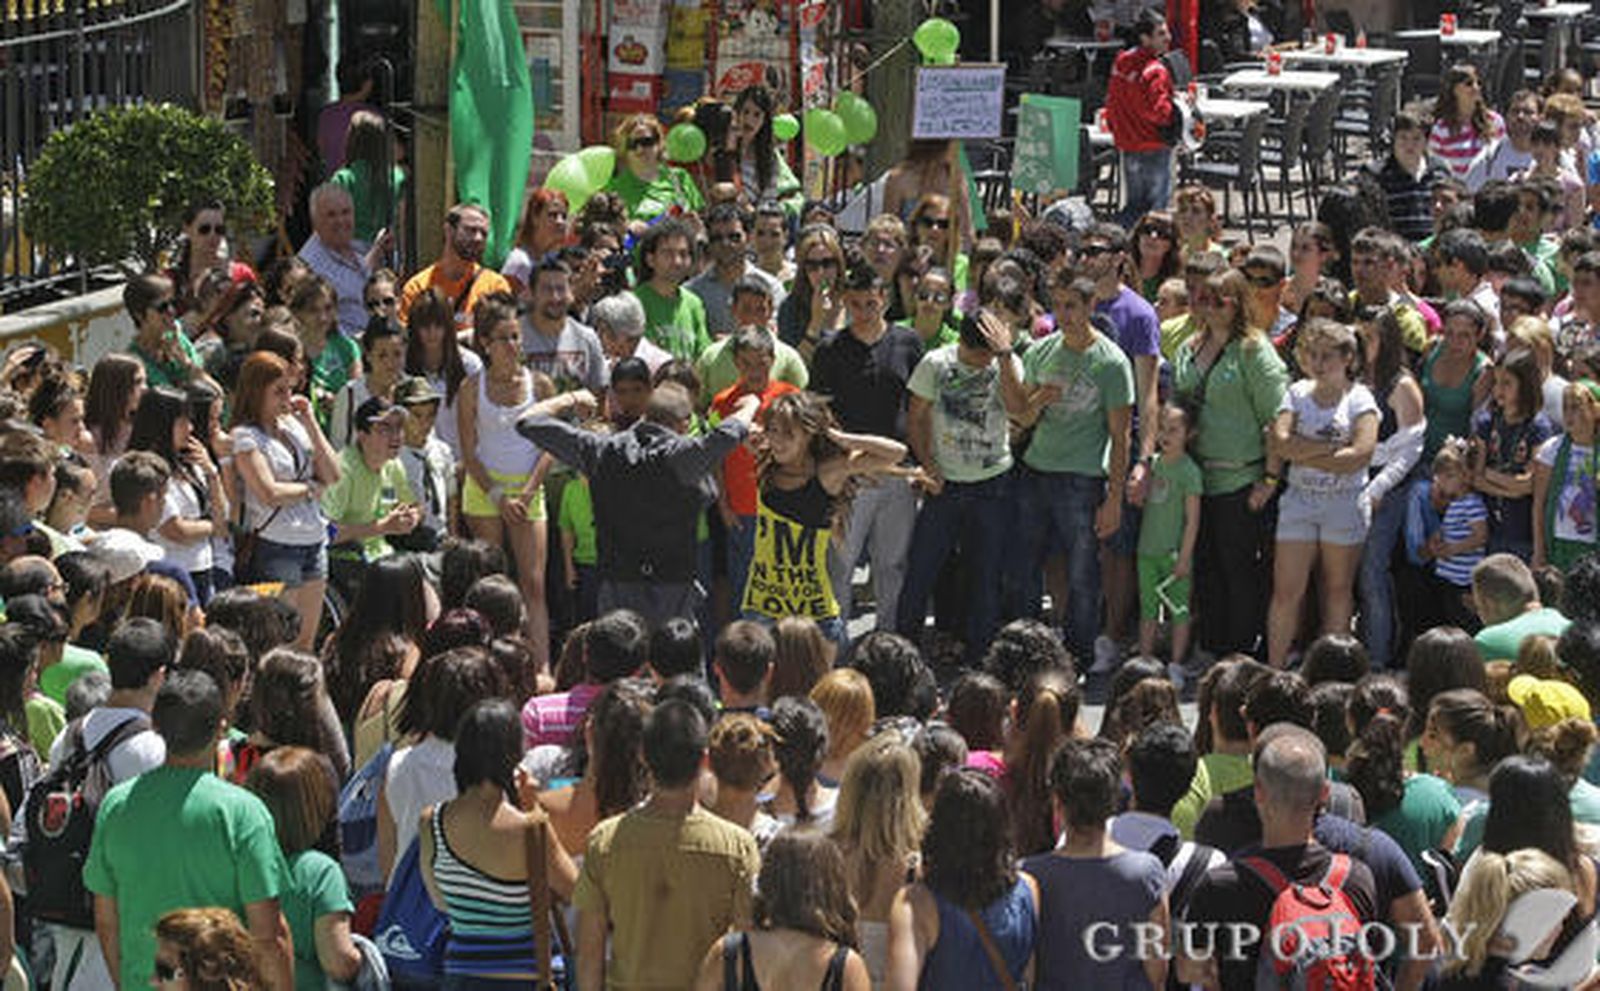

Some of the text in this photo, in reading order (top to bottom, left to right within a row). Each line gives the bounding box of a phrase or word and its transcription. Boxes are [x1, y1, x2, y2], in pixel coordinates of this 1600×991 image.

[759, 515, 817, 566] 'M
[753, 562, 818, 585] N THE
[746, 590, 826, 616] LOVE
